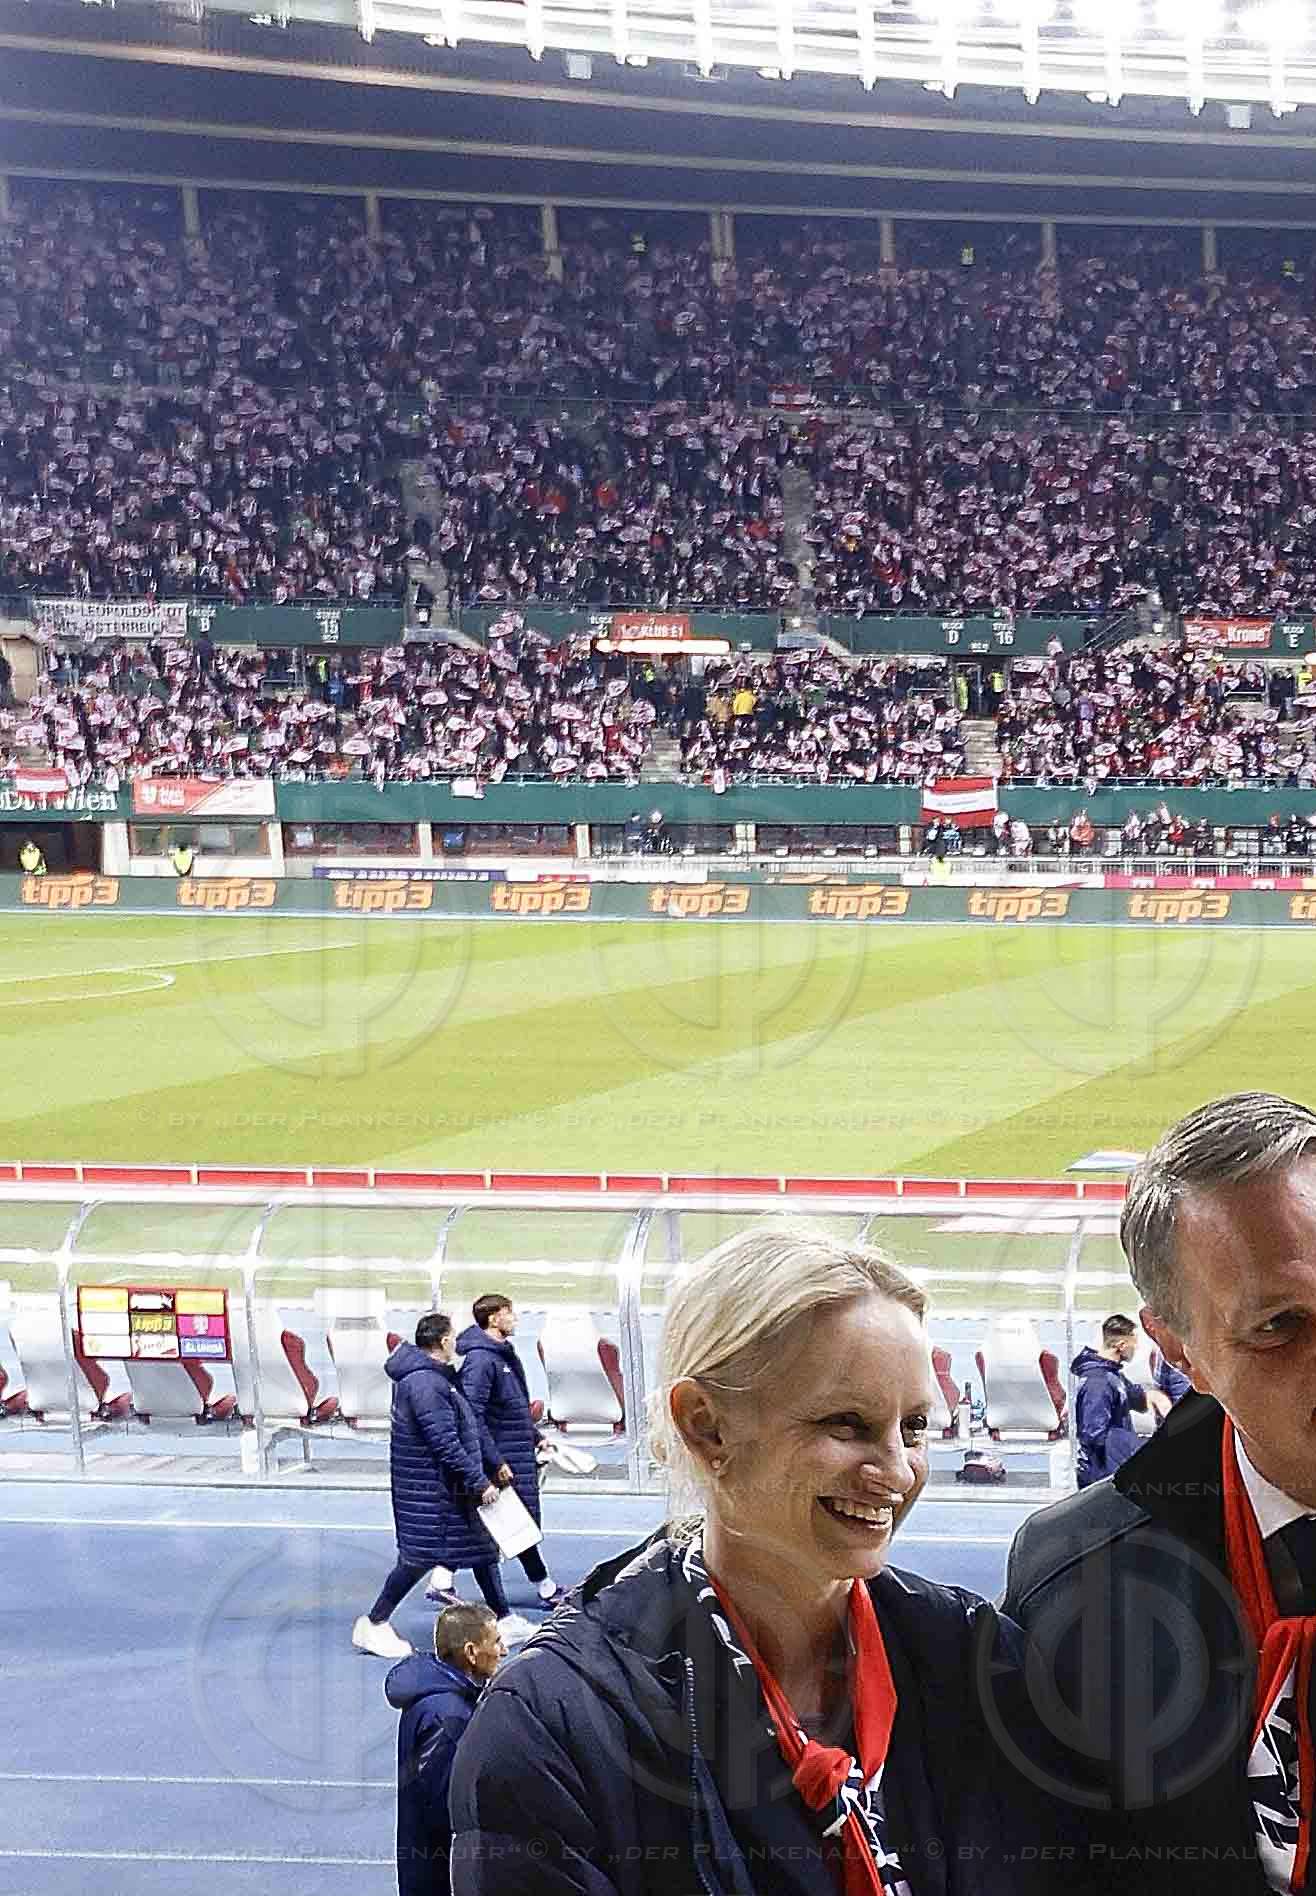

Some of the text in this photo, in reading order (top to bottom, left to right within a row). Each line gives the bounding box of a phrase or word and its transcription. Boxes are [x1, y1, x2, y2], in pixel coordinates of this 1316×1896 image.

[21, 876, 120, 907] tipp3
[177, 879, 276, 907] tipp3
[334, 880, 433, 911] tipp3
[492, 882, 591, 912] tipp3
[808, 884, 911, 918] tipp3
[968, 888, 1072, 921] tipp3
[1127, 888, 1233, 923] tipp3
